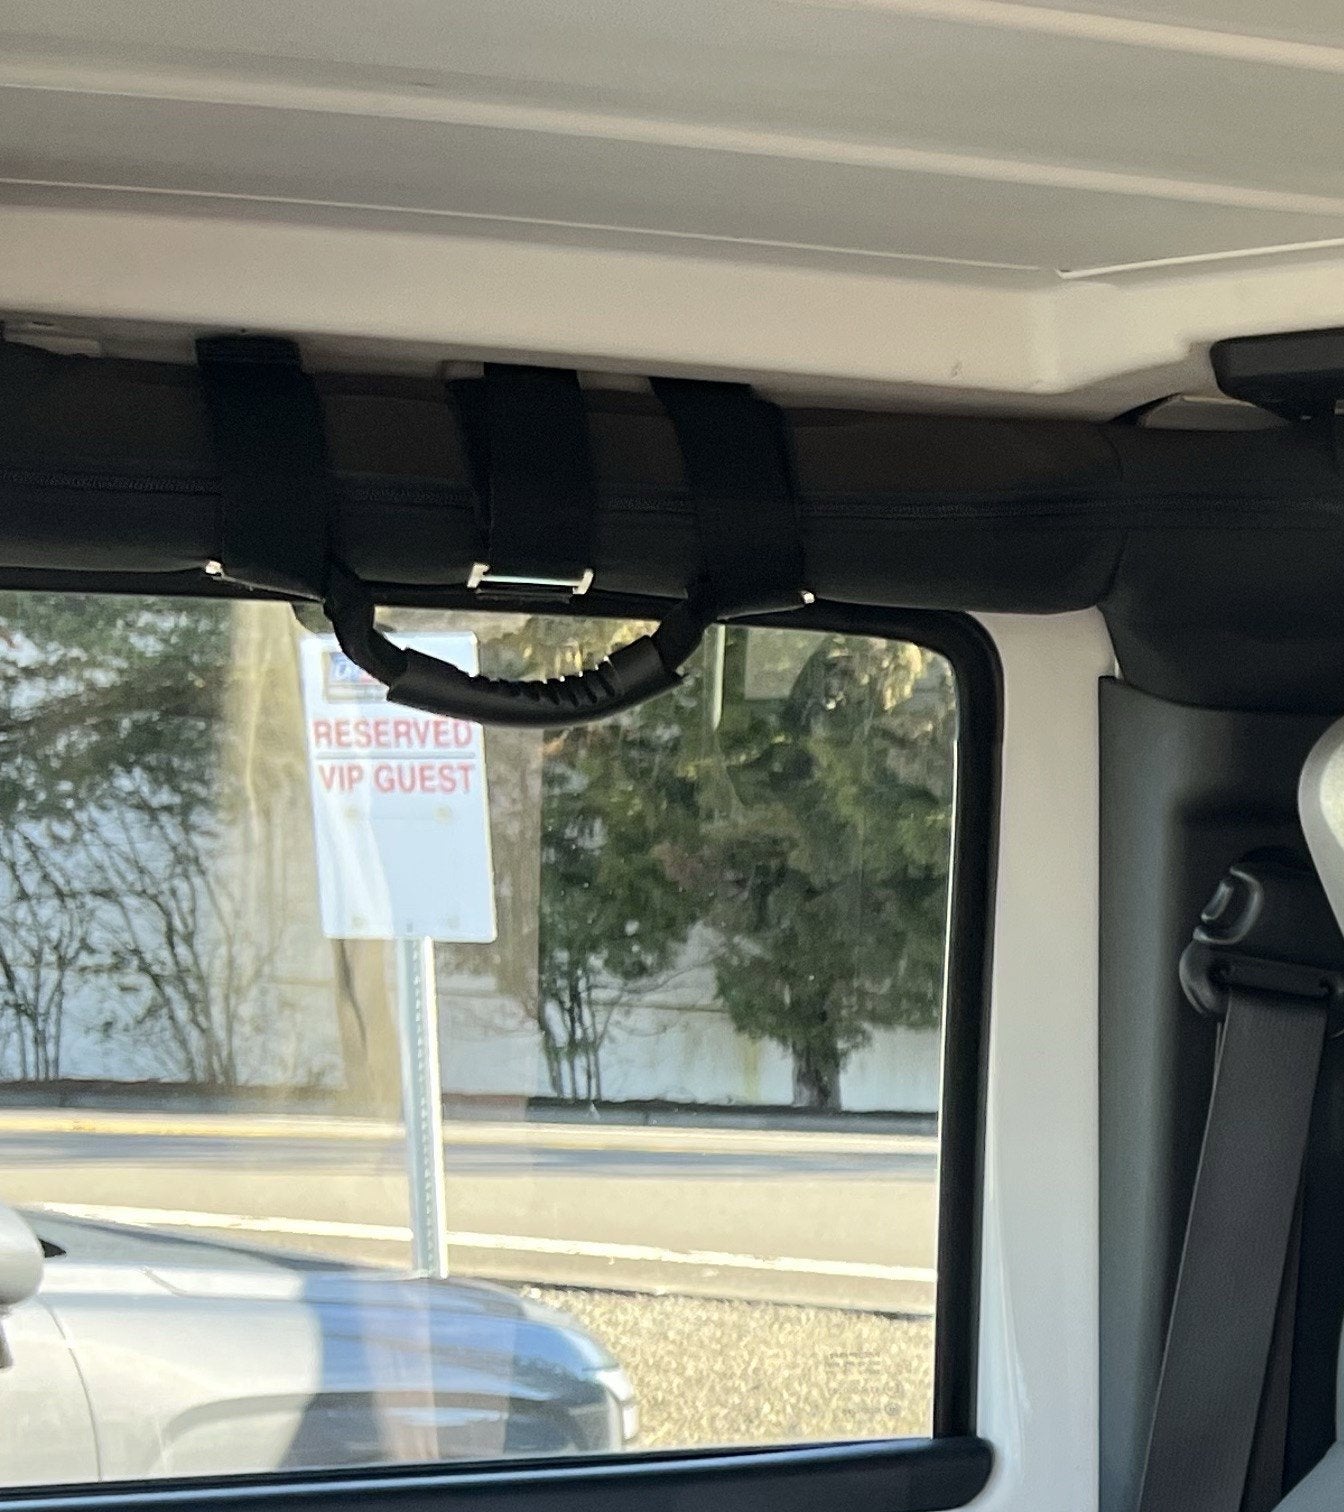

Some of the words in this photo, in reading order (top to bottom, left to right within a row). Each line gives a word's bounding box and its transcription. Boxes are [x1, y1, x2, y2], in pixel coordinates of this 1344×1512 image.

[313, 718, 473, 748] RESERVED
[318, 764, 364, 791] VIP
[373, 763, 475, 793] GUEST
